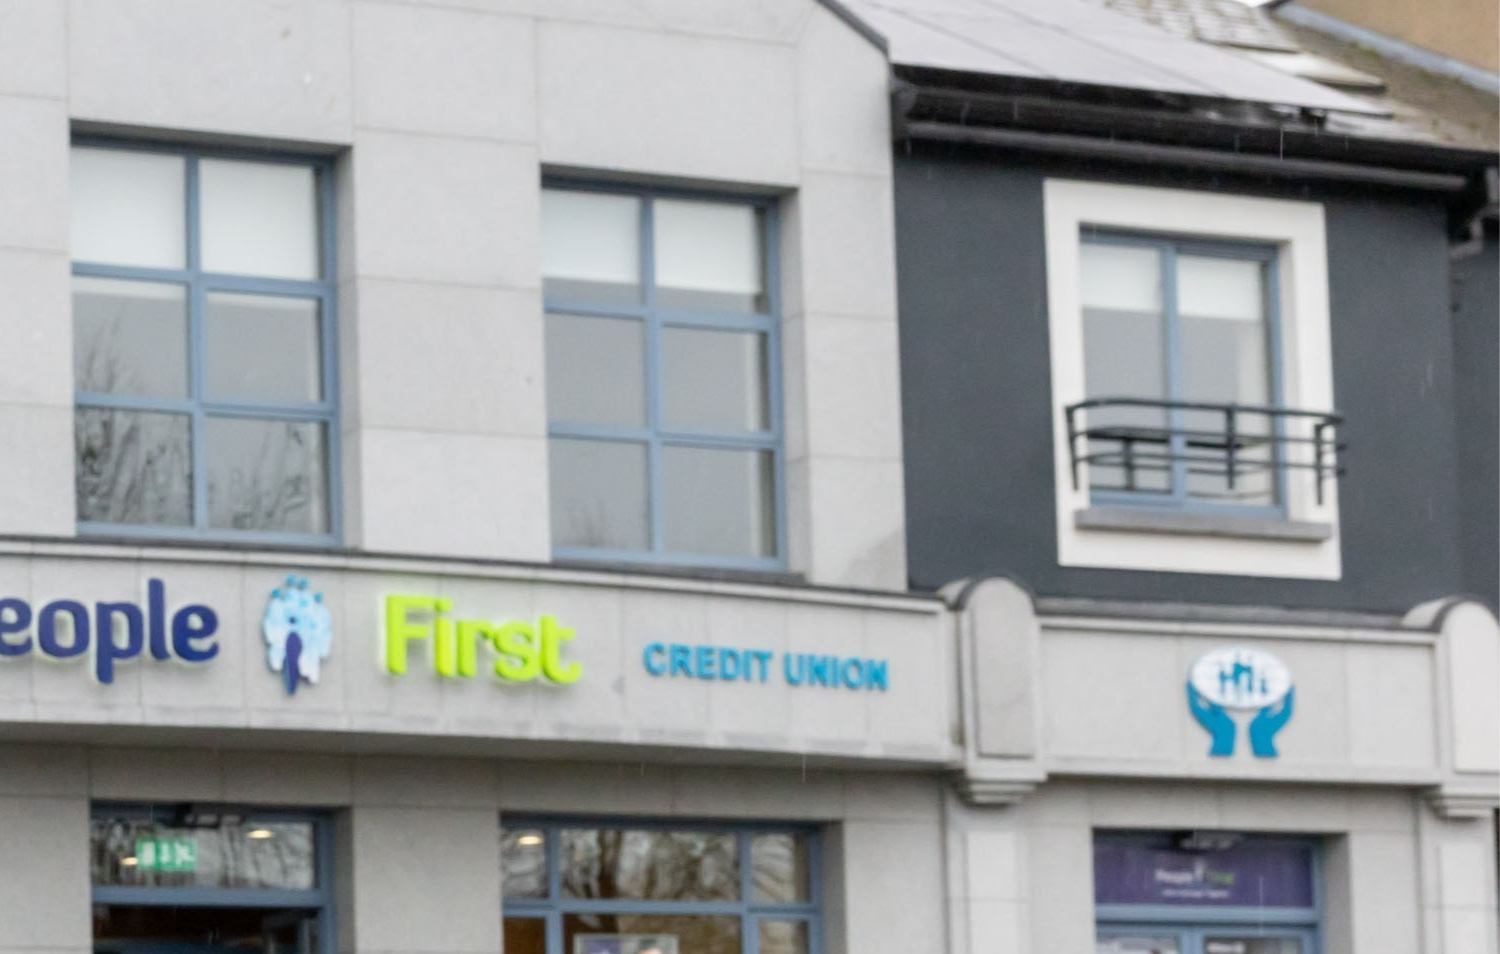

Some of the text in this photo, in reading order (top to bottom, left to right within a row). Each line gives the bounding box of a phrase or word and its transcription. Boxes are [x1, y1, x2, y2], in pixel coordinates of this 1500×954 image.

[384, 593, 582, 684] First
[643, 642, 889, 691] CREDIT UNION
